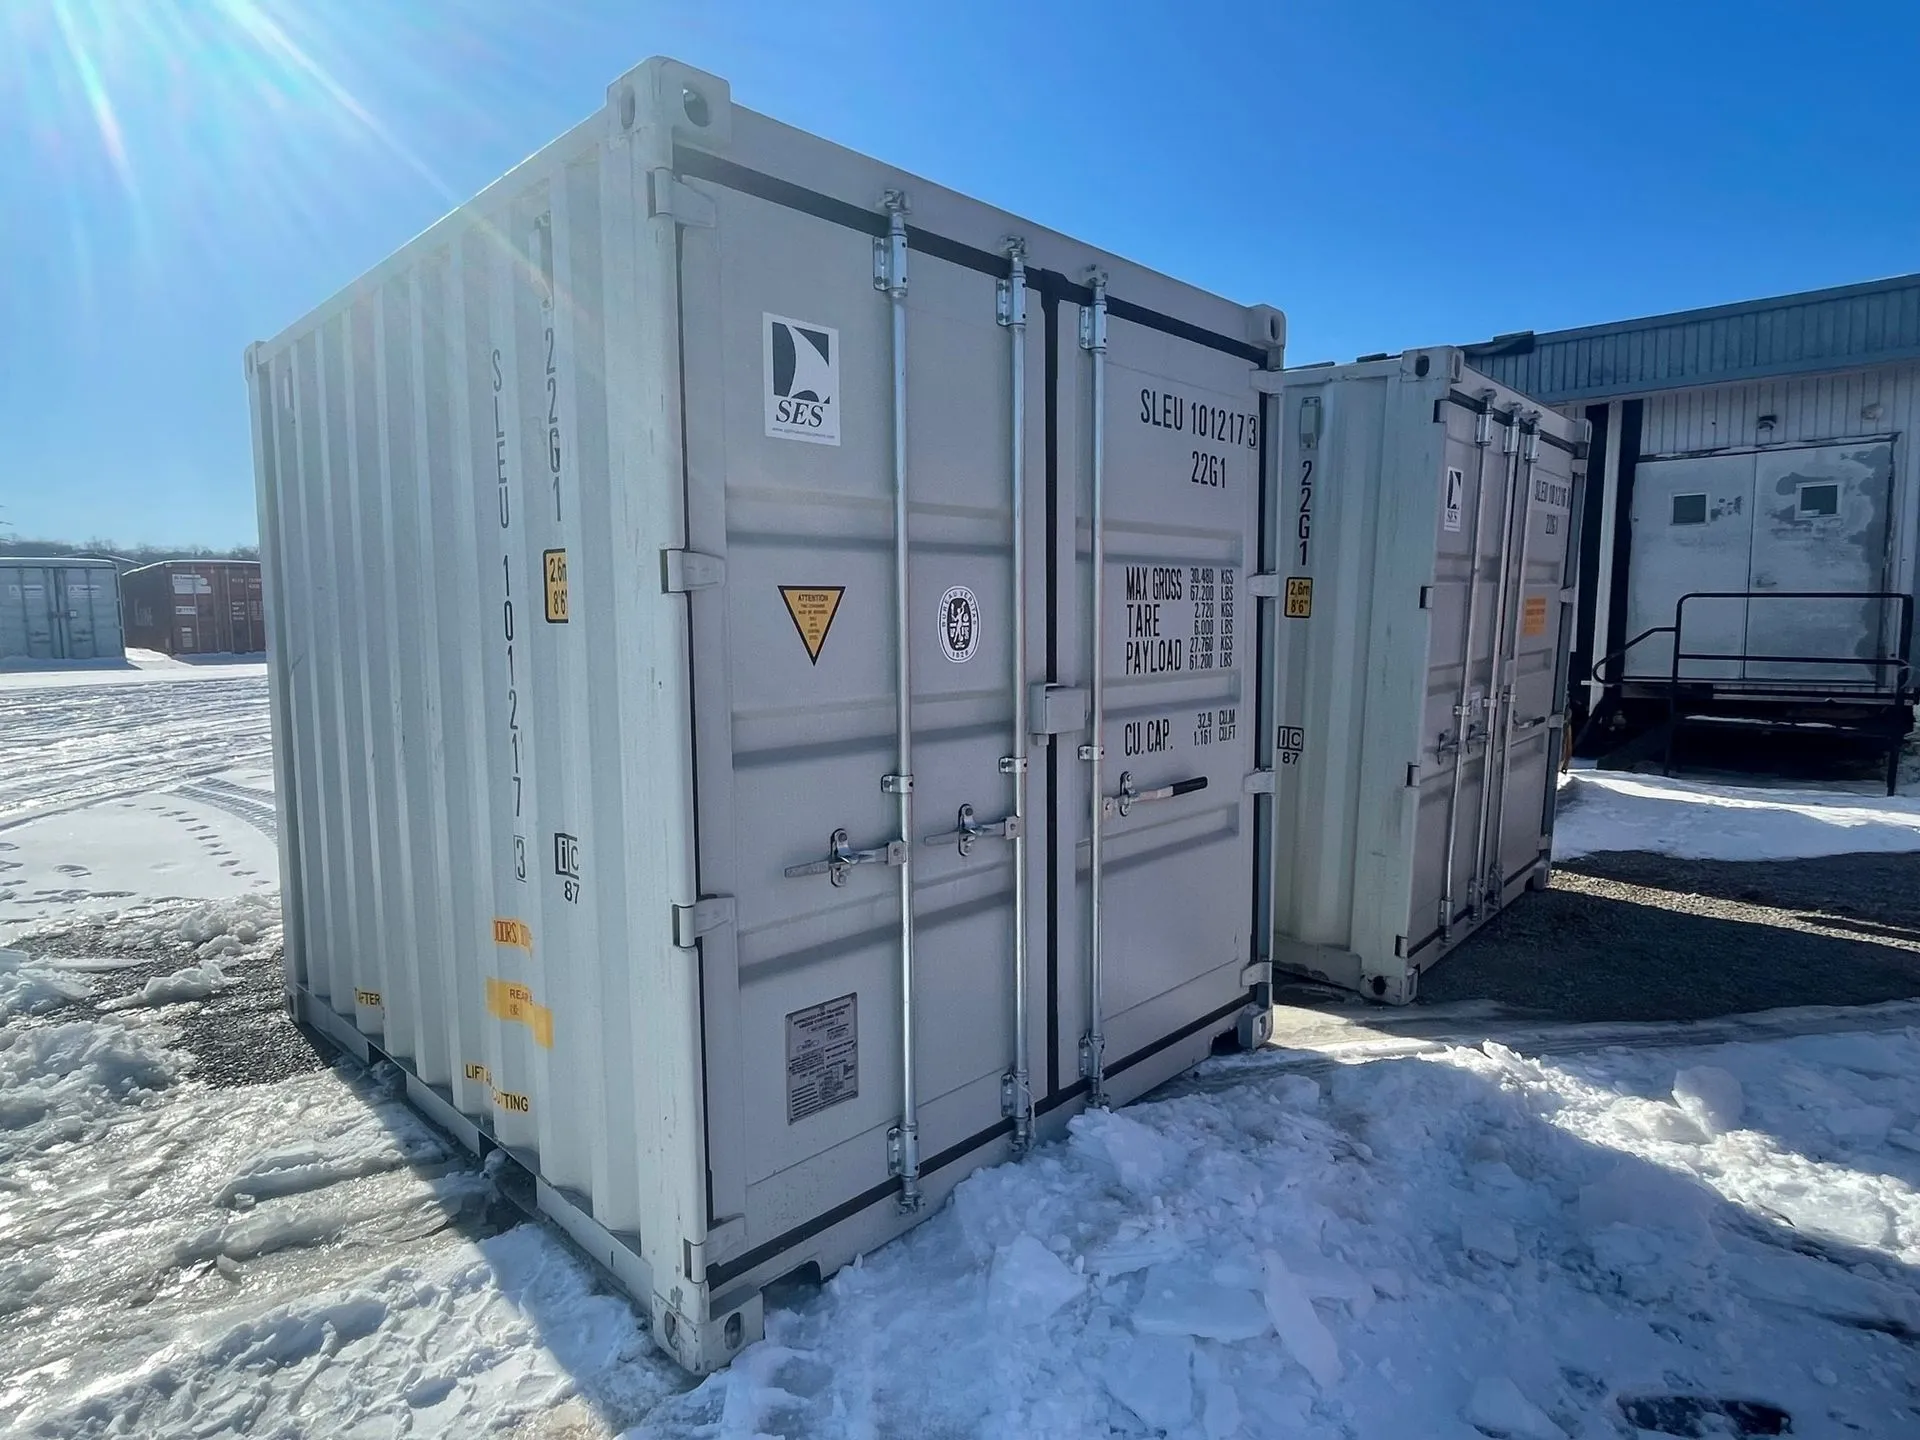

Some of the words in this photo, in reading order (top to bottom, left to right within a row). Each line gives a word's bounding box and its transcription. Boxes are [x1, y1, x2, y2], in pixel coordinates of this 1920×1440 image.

[545, 327, 561, 522] 22G1
[776, 400, 824, 427] SES
[1140, 388, 1184, 431] SLEU
[492, 348, 509, 529] SLEU
[1191, 450, 1225, 489] 22G1
[1299, 460, 1313, 566] 22G1
[1126, 566, 1148, 601] MAX
[1153, 567, 1182, 601] GROSS
[1190, 568, 1214, 584] 30.480
[1221, 569, 1234, 585] KGS
[1190, 585, 1214, 601] 67.200
[1220, 586, 1234, 601] LBS
[1126, 603, 1160, 638] TARE
[1195, 602, 1214, 618] 2.720
[1220, 602, 1234, 618] KGS
[1194, 619, 1214, 635] 6.000
[1220, 619, 1233, 635] LBS
[1125, 639, 1182, 675] PAYLOAD
[1220, 636, 1233, 651] KGS
[1189, 653, 1214, 670] 61.200
[1220, 652, 1233, 668] LBS
[1193, 729, 1212, 747] 1.161
[1282, 751, 1299, 765] 87
[564, 880, 580, 905] 87
